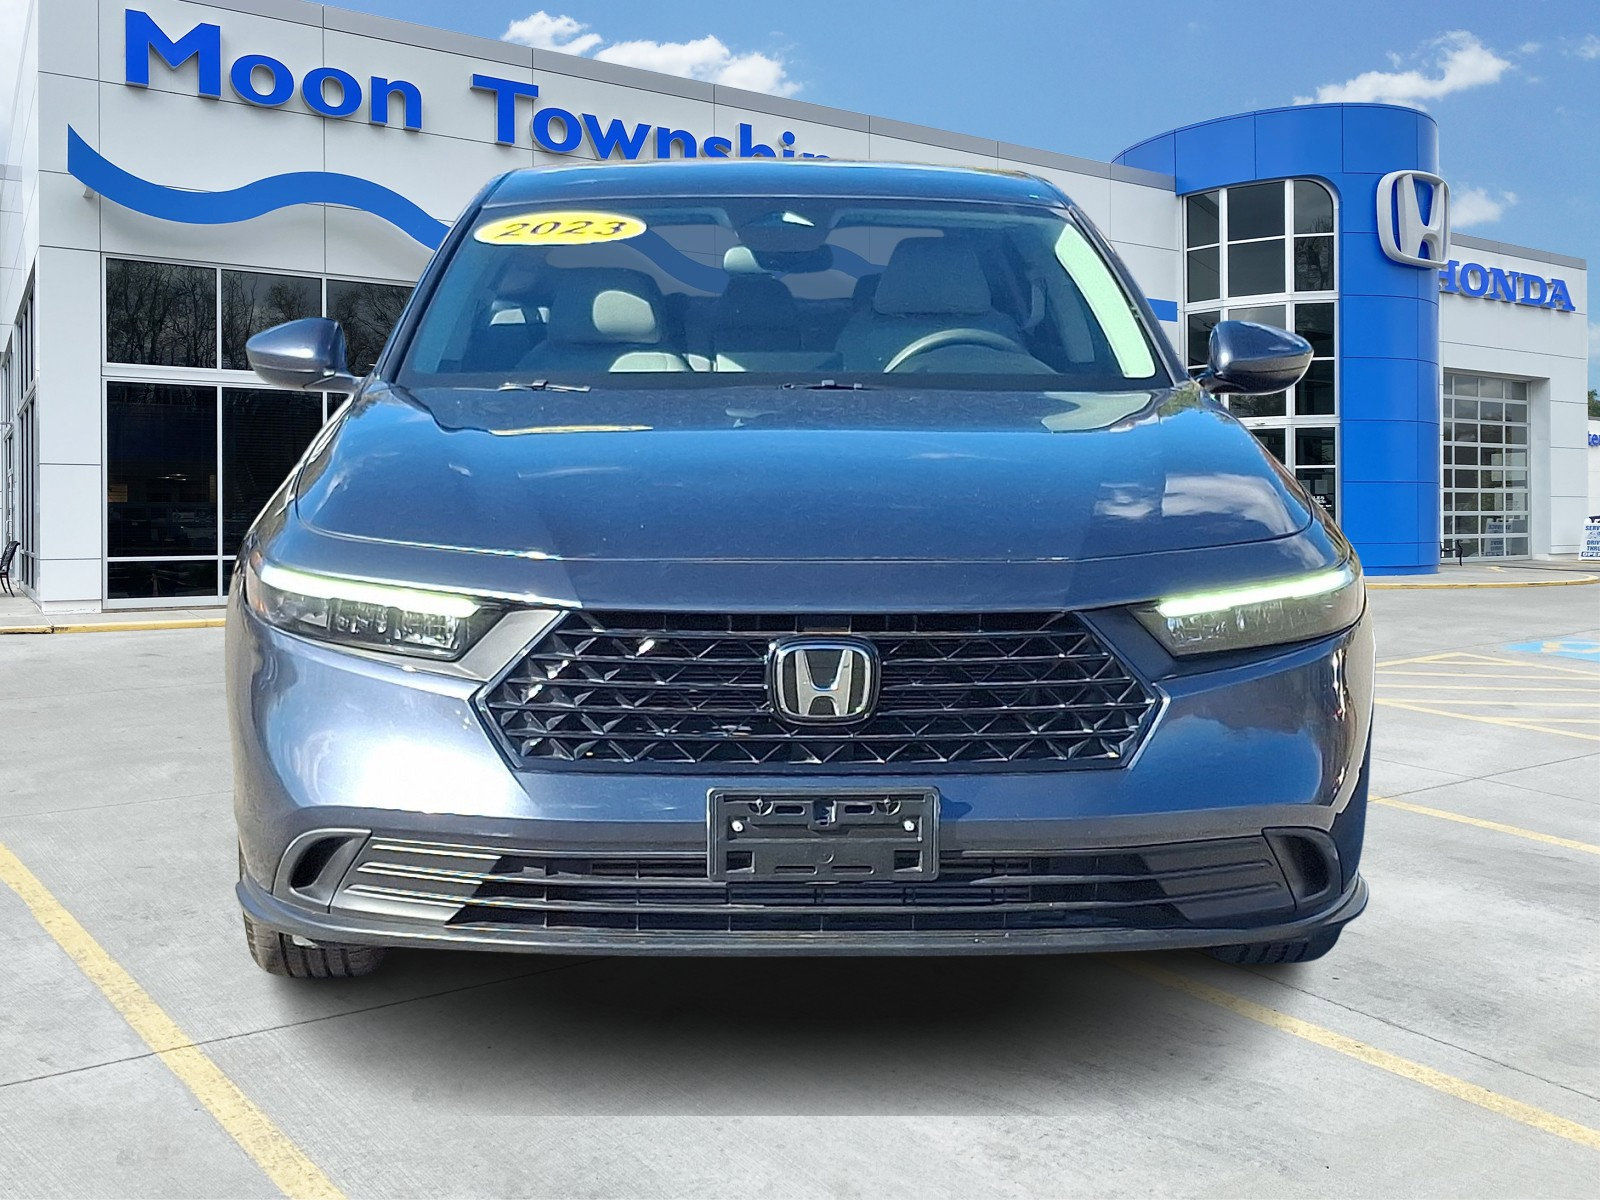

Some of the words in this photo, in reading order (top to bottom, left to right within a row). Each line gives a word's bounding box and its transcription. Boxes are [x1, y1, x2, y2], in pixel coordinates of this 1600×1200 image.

[125, 9, 422, 131] Moon
[469, 73, 831, 160] Townshi
[494, 220, 627, 239] 2023
